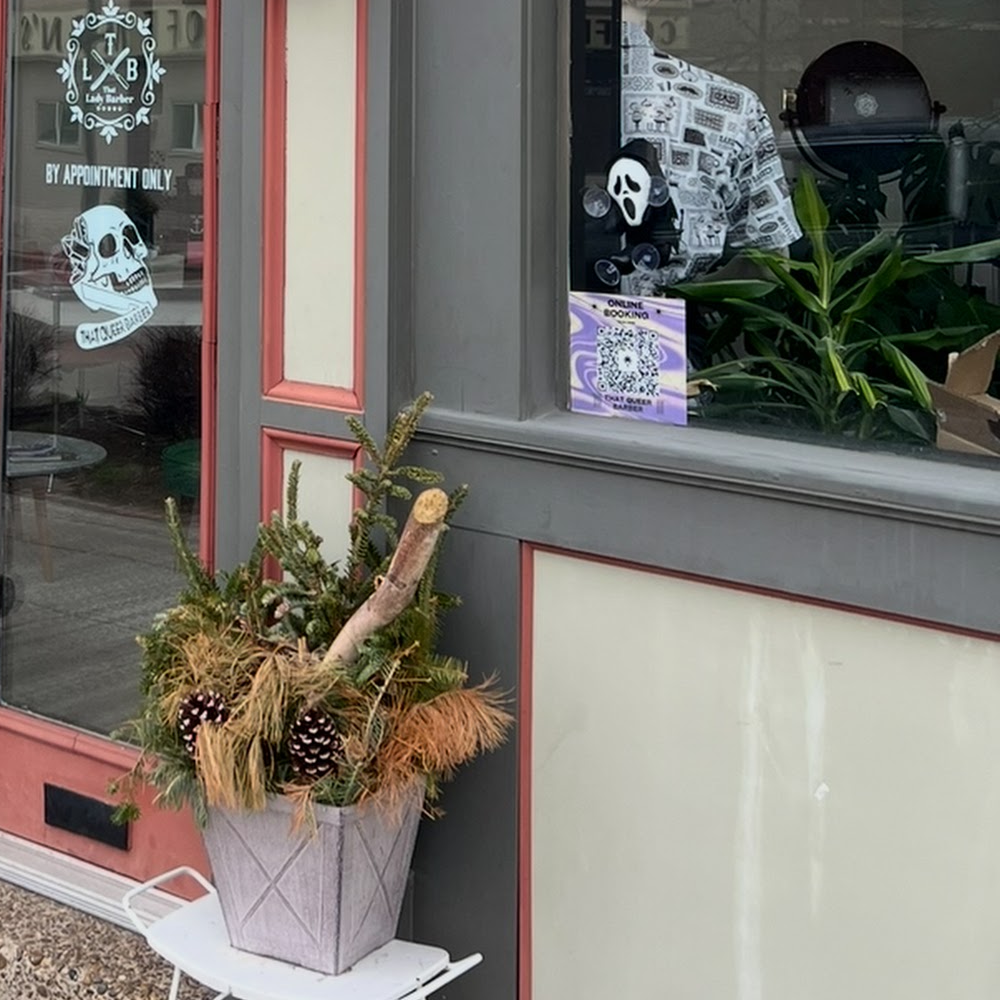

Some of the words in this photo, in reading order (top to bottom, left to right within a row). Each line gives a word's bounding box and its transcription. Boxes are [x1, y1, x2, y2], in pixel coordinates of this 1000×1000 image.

[104, 33, 117, 56] T
[82, 58, 92, 81] L
[126, 58, 139, 81] B
[85, 93, 103, 106] Lady
[105, 93, 135, 104] Barber
[45, 162, 60, 184] BY
[62, 164, 139, 189] APPOINTMENT
[141, 167, 173, 191] ONLY
[607, 298, 644, 310] ONLINE
[603, 308, 649, 320] BOOKING
[100, 319, 126, 342] QUEER
[613, 403, 643, 412] BARBER
[626, 396, 652, 406] QUEER
